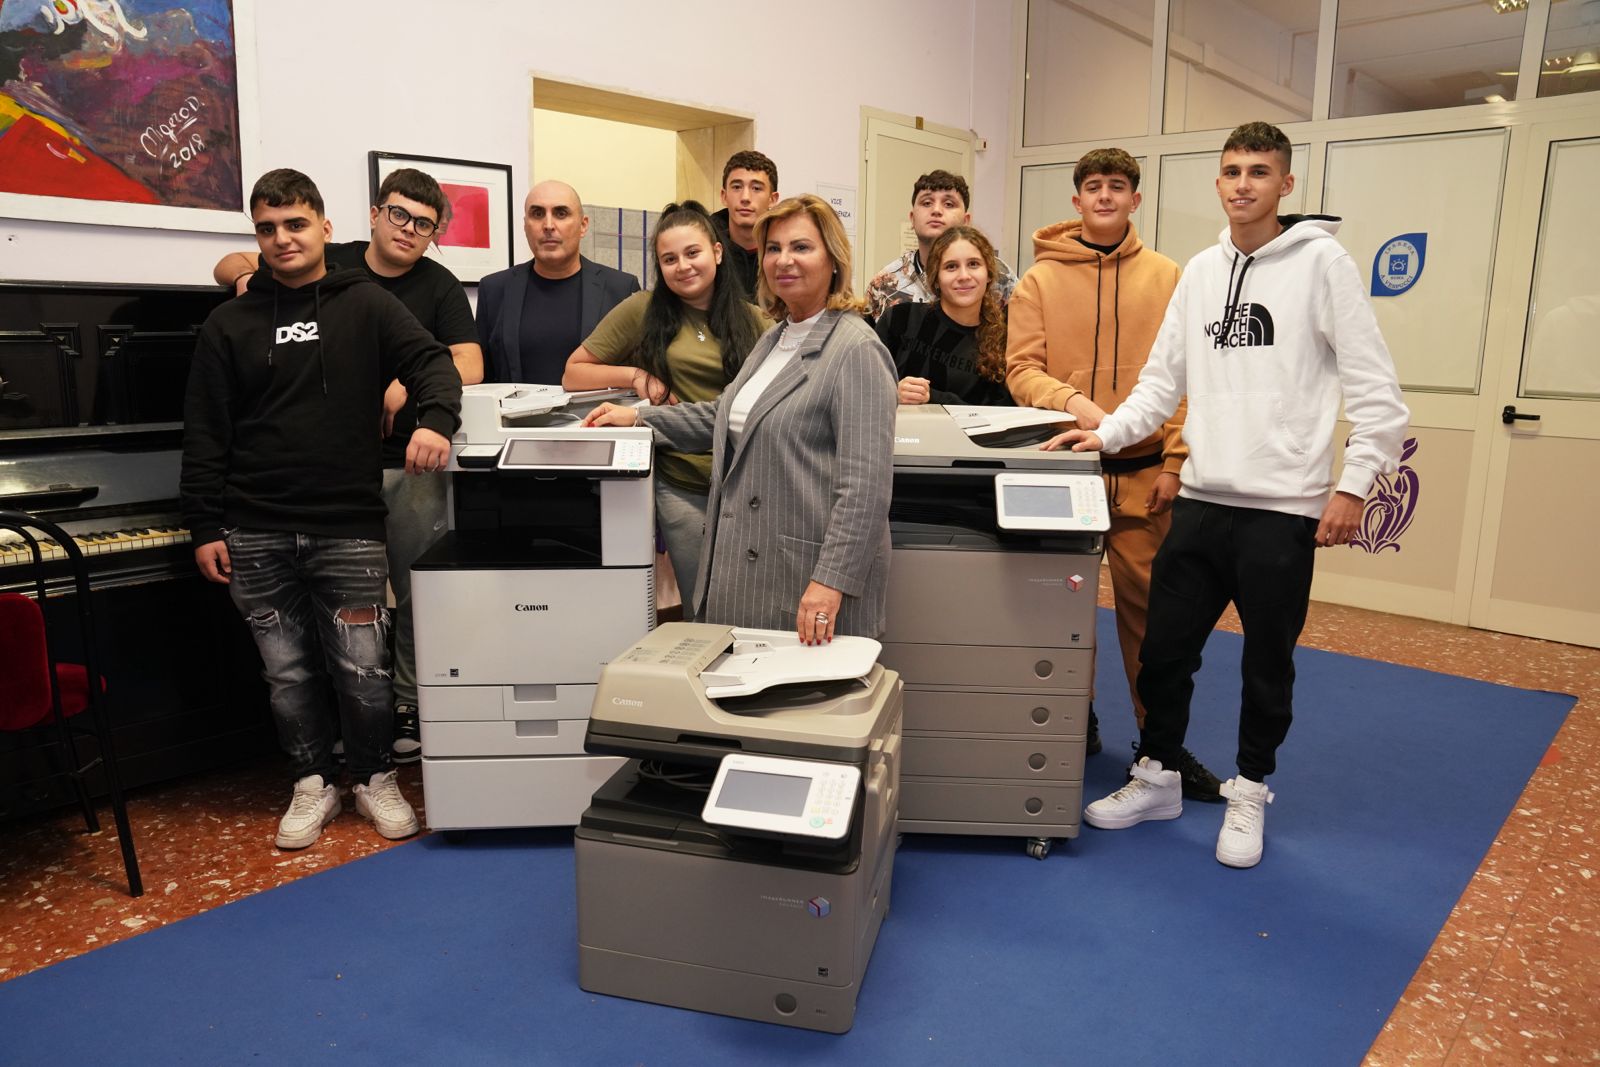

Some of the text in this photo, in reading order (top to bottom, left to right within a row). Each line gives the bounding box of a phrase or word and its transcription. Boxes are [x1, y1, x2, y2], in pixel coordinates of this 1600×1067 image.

[169, 133, 205, 169] 2018
[275, 321, 320, 345] DS2
[1214, 332, 1247, 350] FACE
[895, 436, 920, 444] Canon
[514, 603, 549, 612] Canon
[611, 697, 644, 708] Canon
